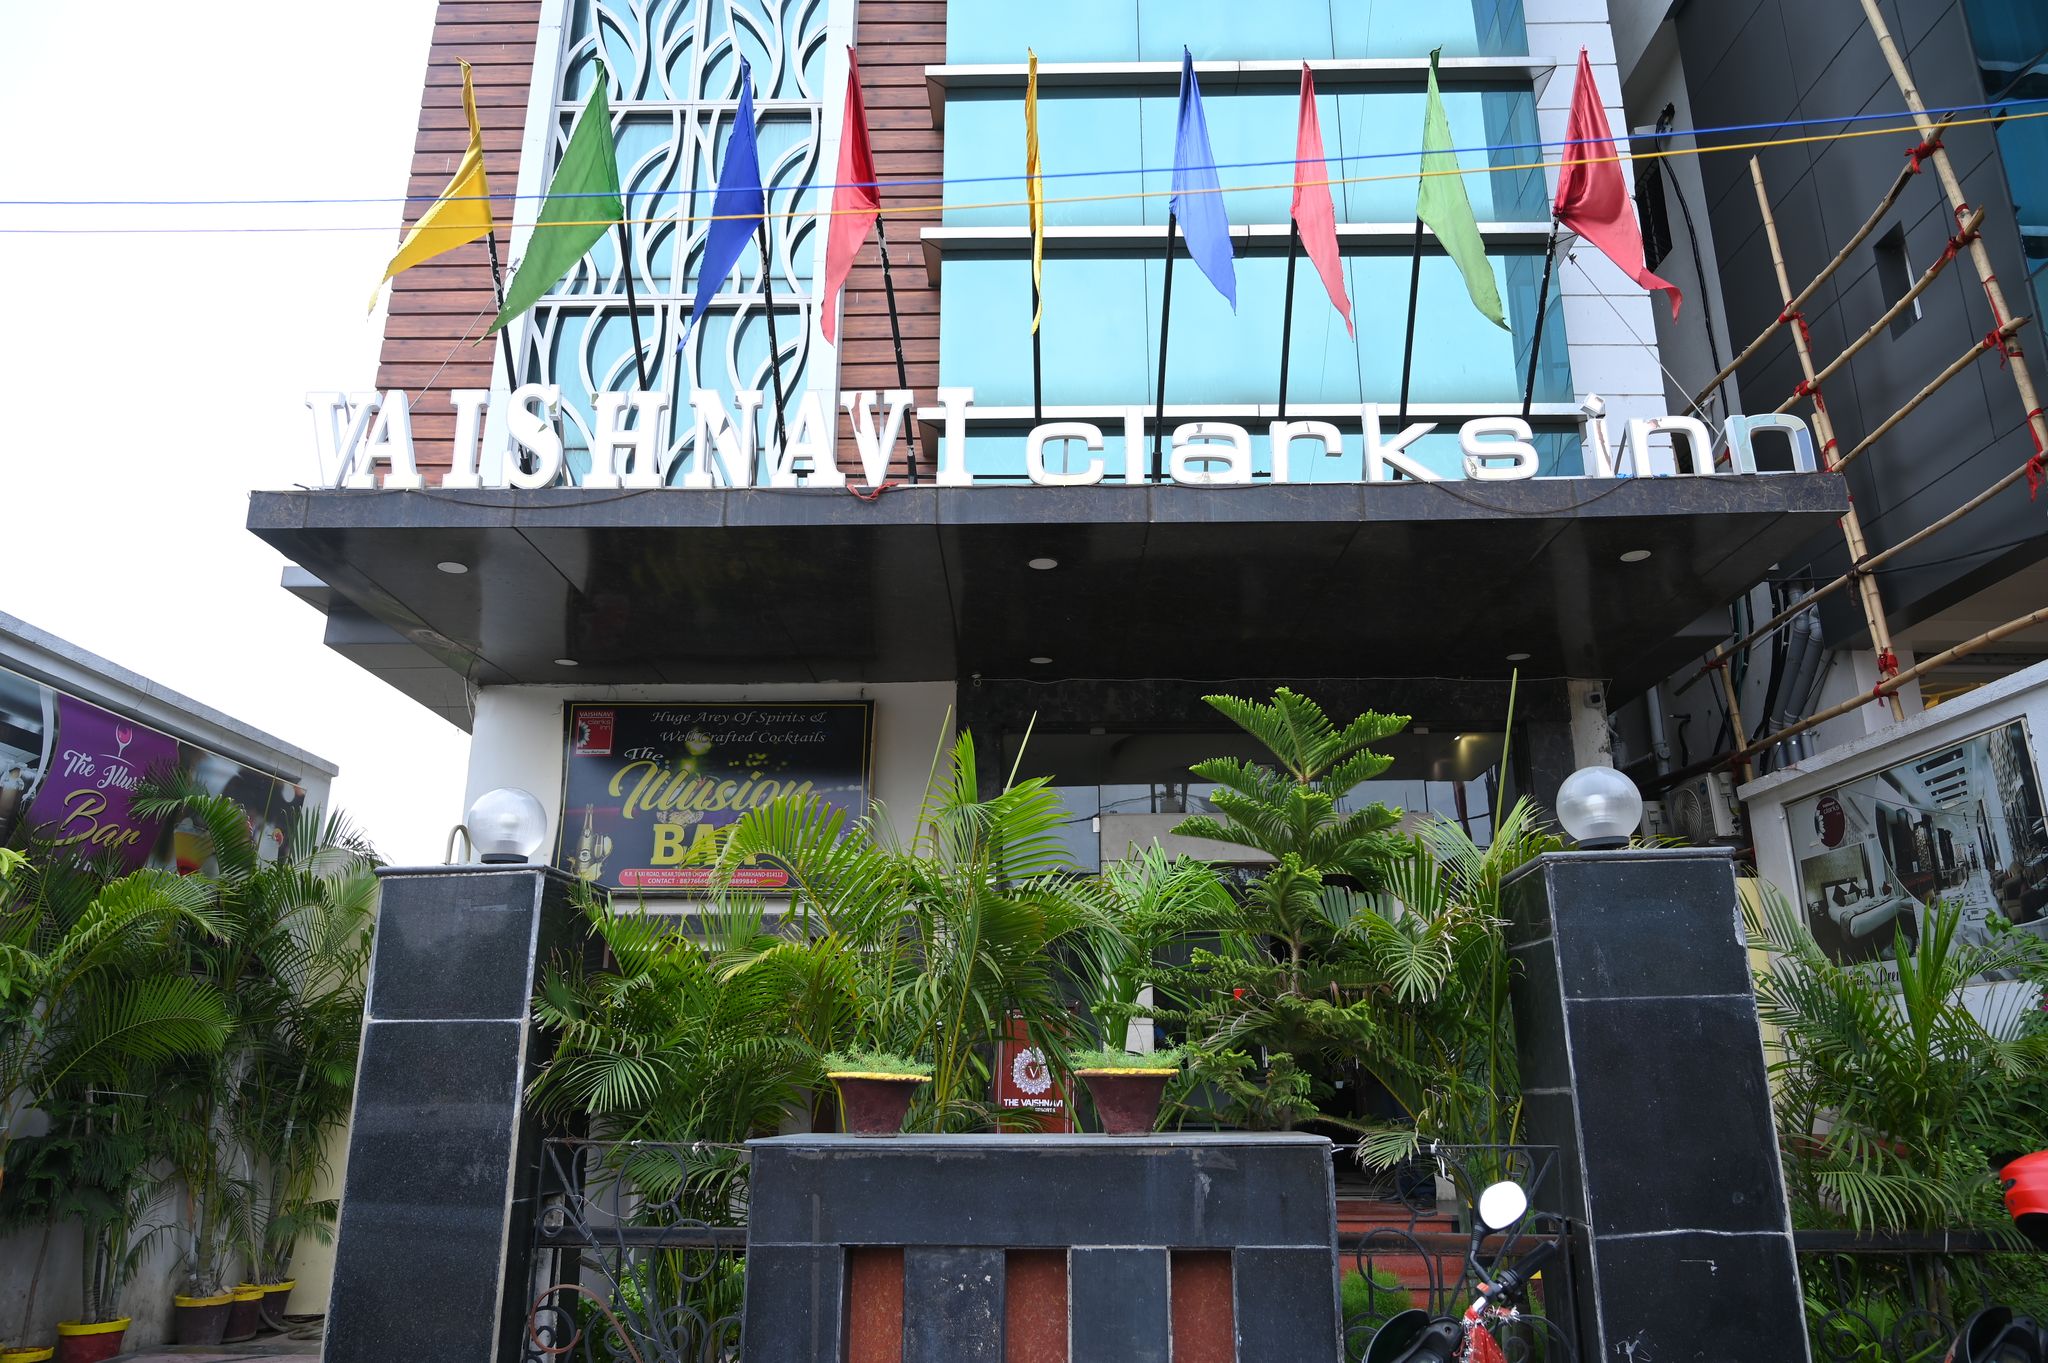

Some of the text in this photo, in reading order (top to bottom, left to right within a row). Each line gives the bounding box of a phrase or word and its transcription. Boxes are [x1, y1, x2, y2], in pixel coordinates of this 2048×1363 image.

[305, 384, 1816, 490] VAISHNAVI clarks inn
[650, 711, 827, 725] Huge Arey Of Spirits &
[699, 730, 758, 746] Crafted
[758, 731, 826, 746] Cocktails
[63, 749, 97, 778] The
[624, 746, 663, 761] The
[607, 760, 815, 819] Illusion
[32, 788, 141, 849] Bar
[650, 823, 757, 866] BA
[1003, 1098, 1063, 1108] THE VAISHNAVI
